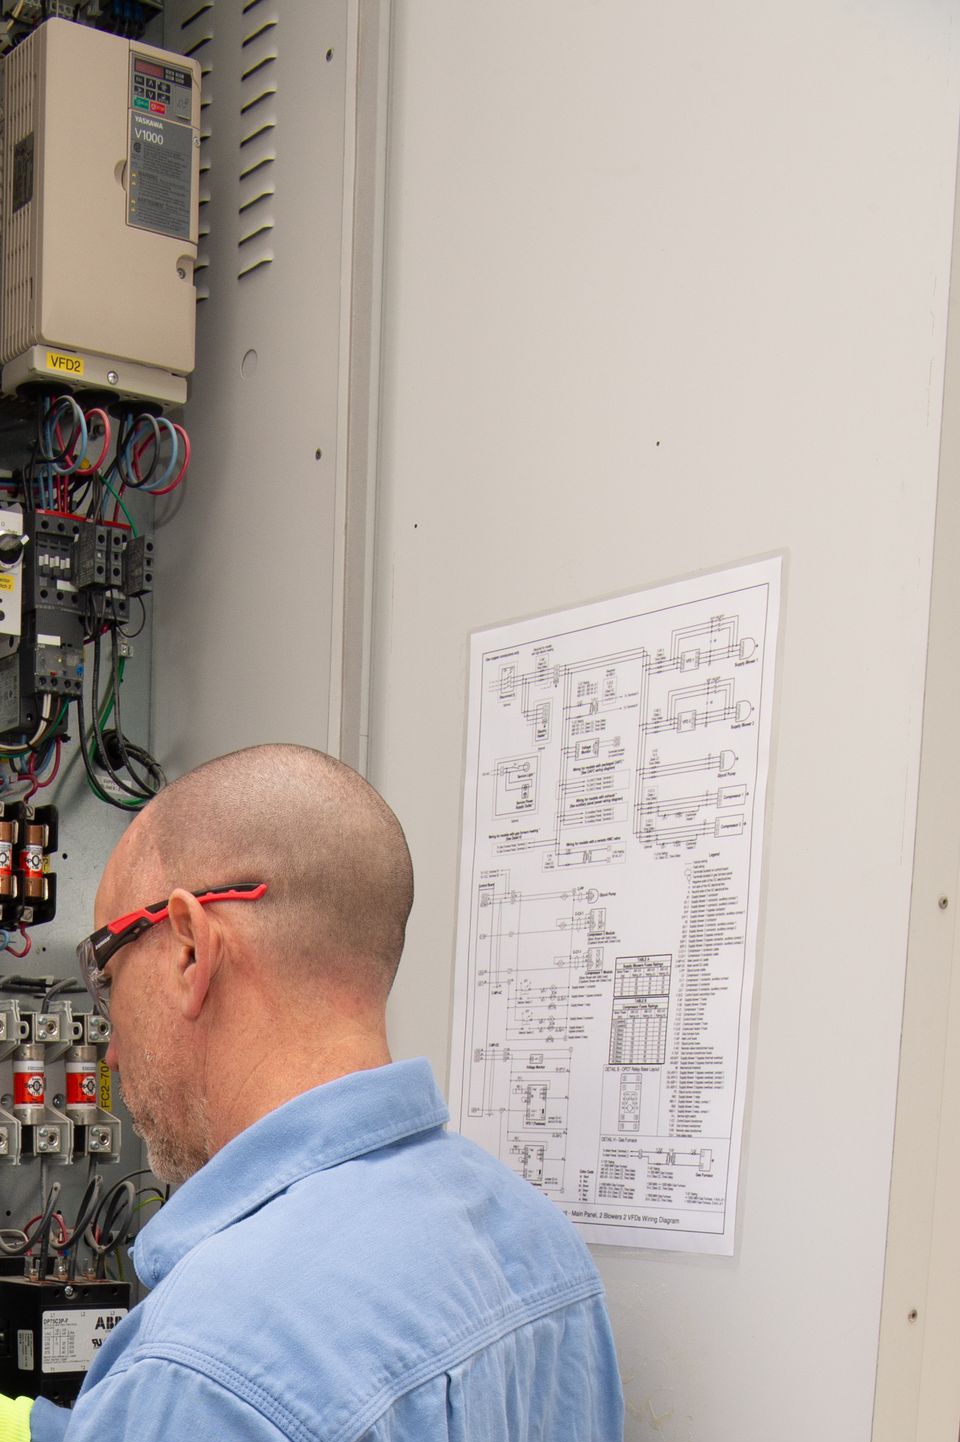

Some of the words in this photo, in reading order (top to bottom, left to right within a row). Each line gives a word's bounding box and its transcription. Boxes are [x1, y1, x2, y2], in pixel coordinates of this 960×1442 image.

[134, 115, 163, 129] YASKAWA
[135, 128, 163, 145] V1000
[51, 355, 80, 372] VFD2
[642, 1215, 658, 1224] Wiring
[659, 1216, 680, 1225] Diagram
